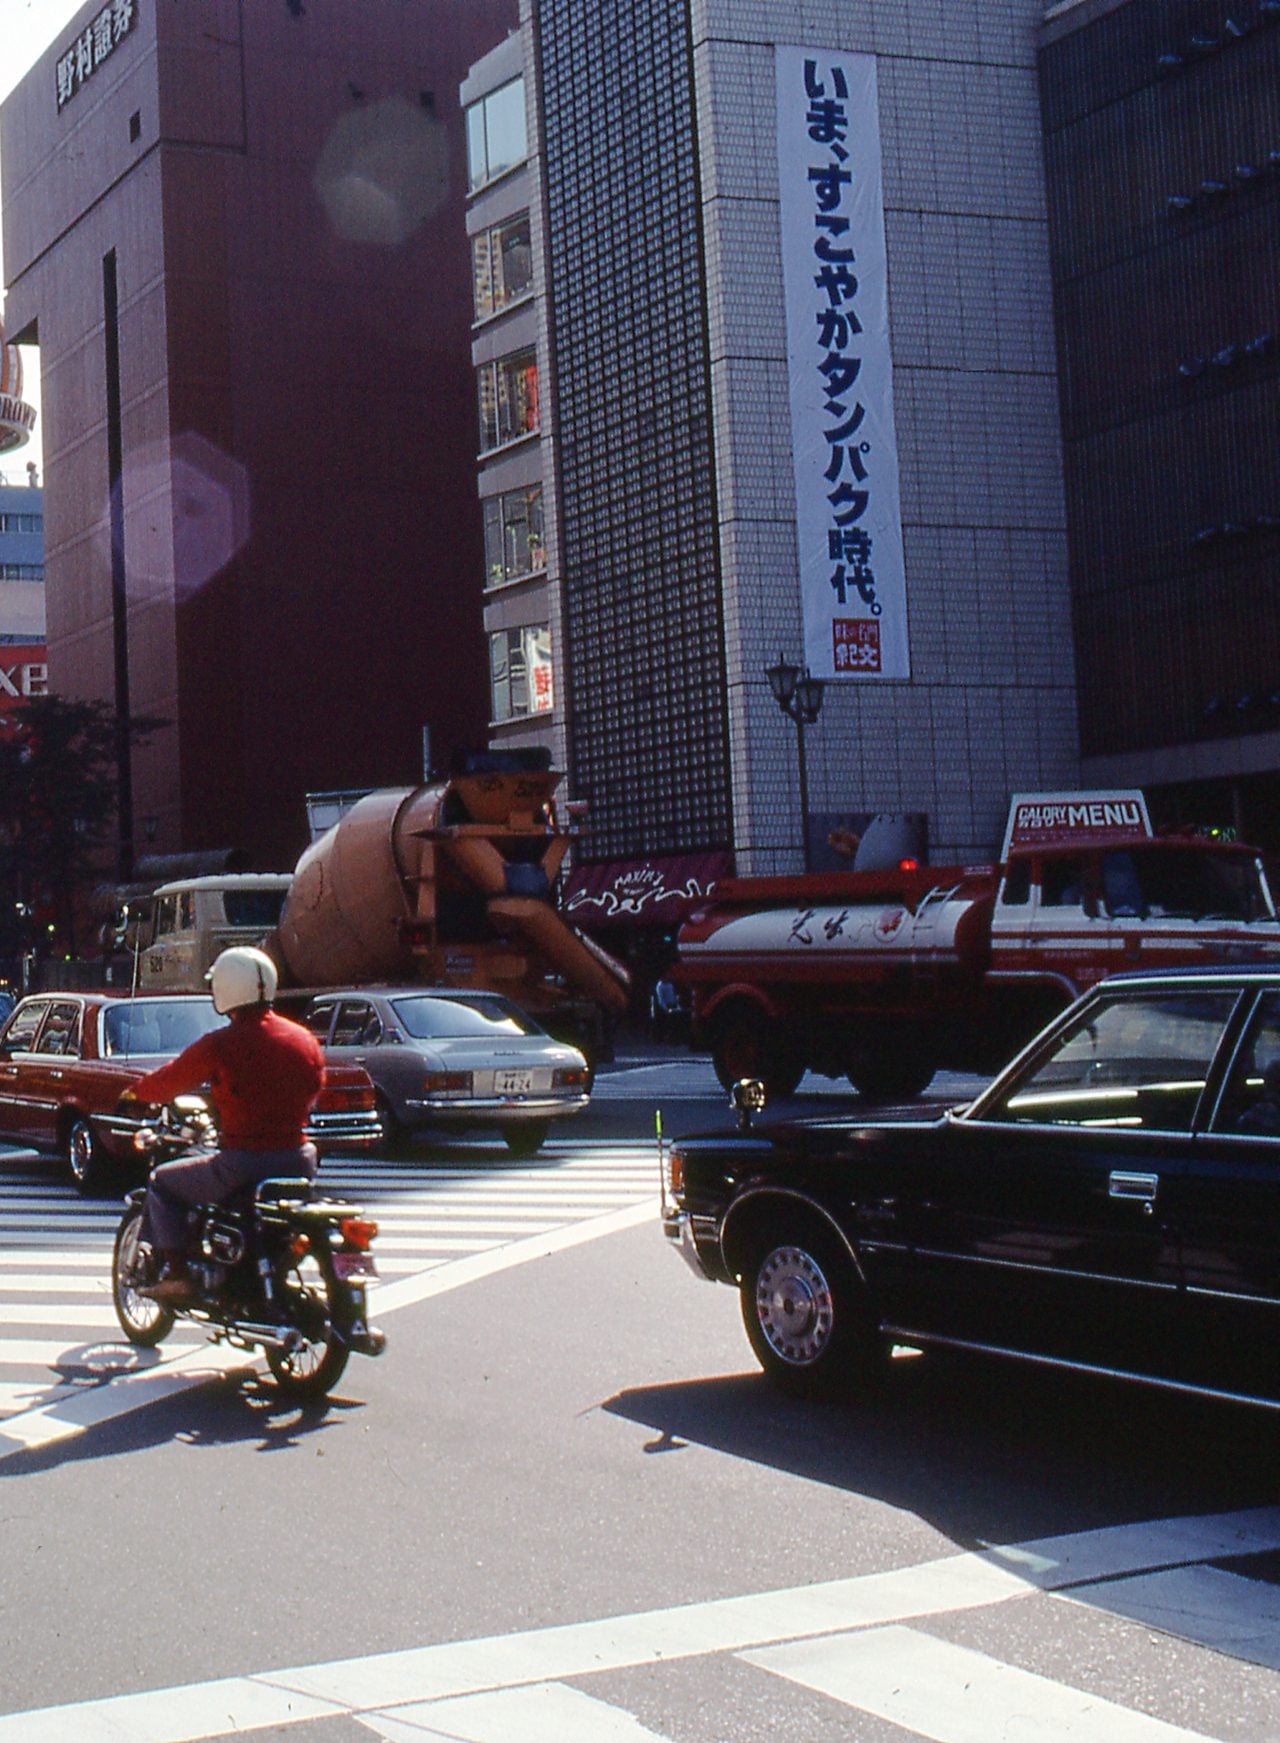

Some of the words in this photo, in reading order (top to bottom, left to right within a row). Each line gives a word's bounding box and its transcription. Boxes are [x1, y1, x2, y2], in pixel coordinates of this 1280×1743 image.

[804, 58, 882, 617] いま、すこやかタンパク時代。
[836, 642, 879, 668] 紀文
[1068, 802, 1141, 827] MENU
